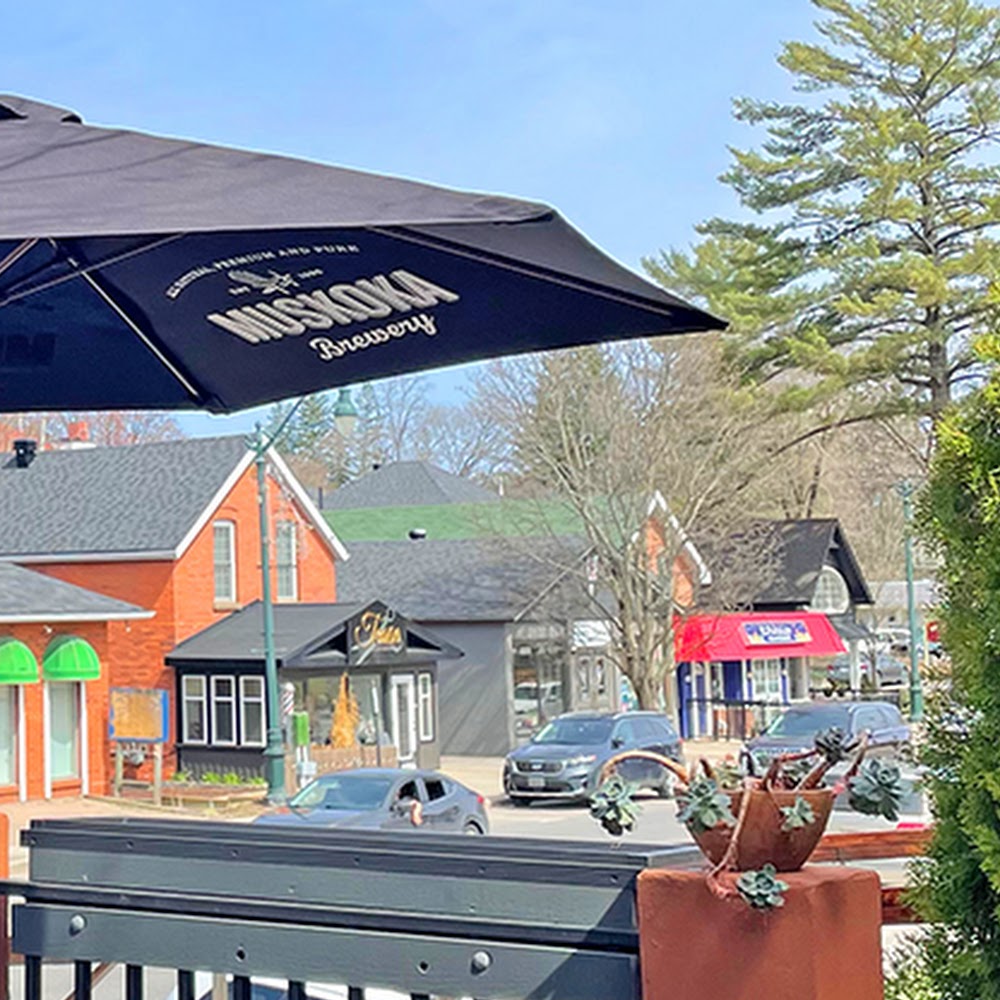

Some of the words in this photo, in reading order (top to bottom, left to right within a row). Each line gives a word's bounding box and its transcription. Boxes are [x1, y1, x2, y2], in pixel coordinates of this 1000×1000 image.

[279, 247, 310, 257] AND
[207, 269, 460, 343] MUSKOKA
[310, 312, 437, 360] Brewery
